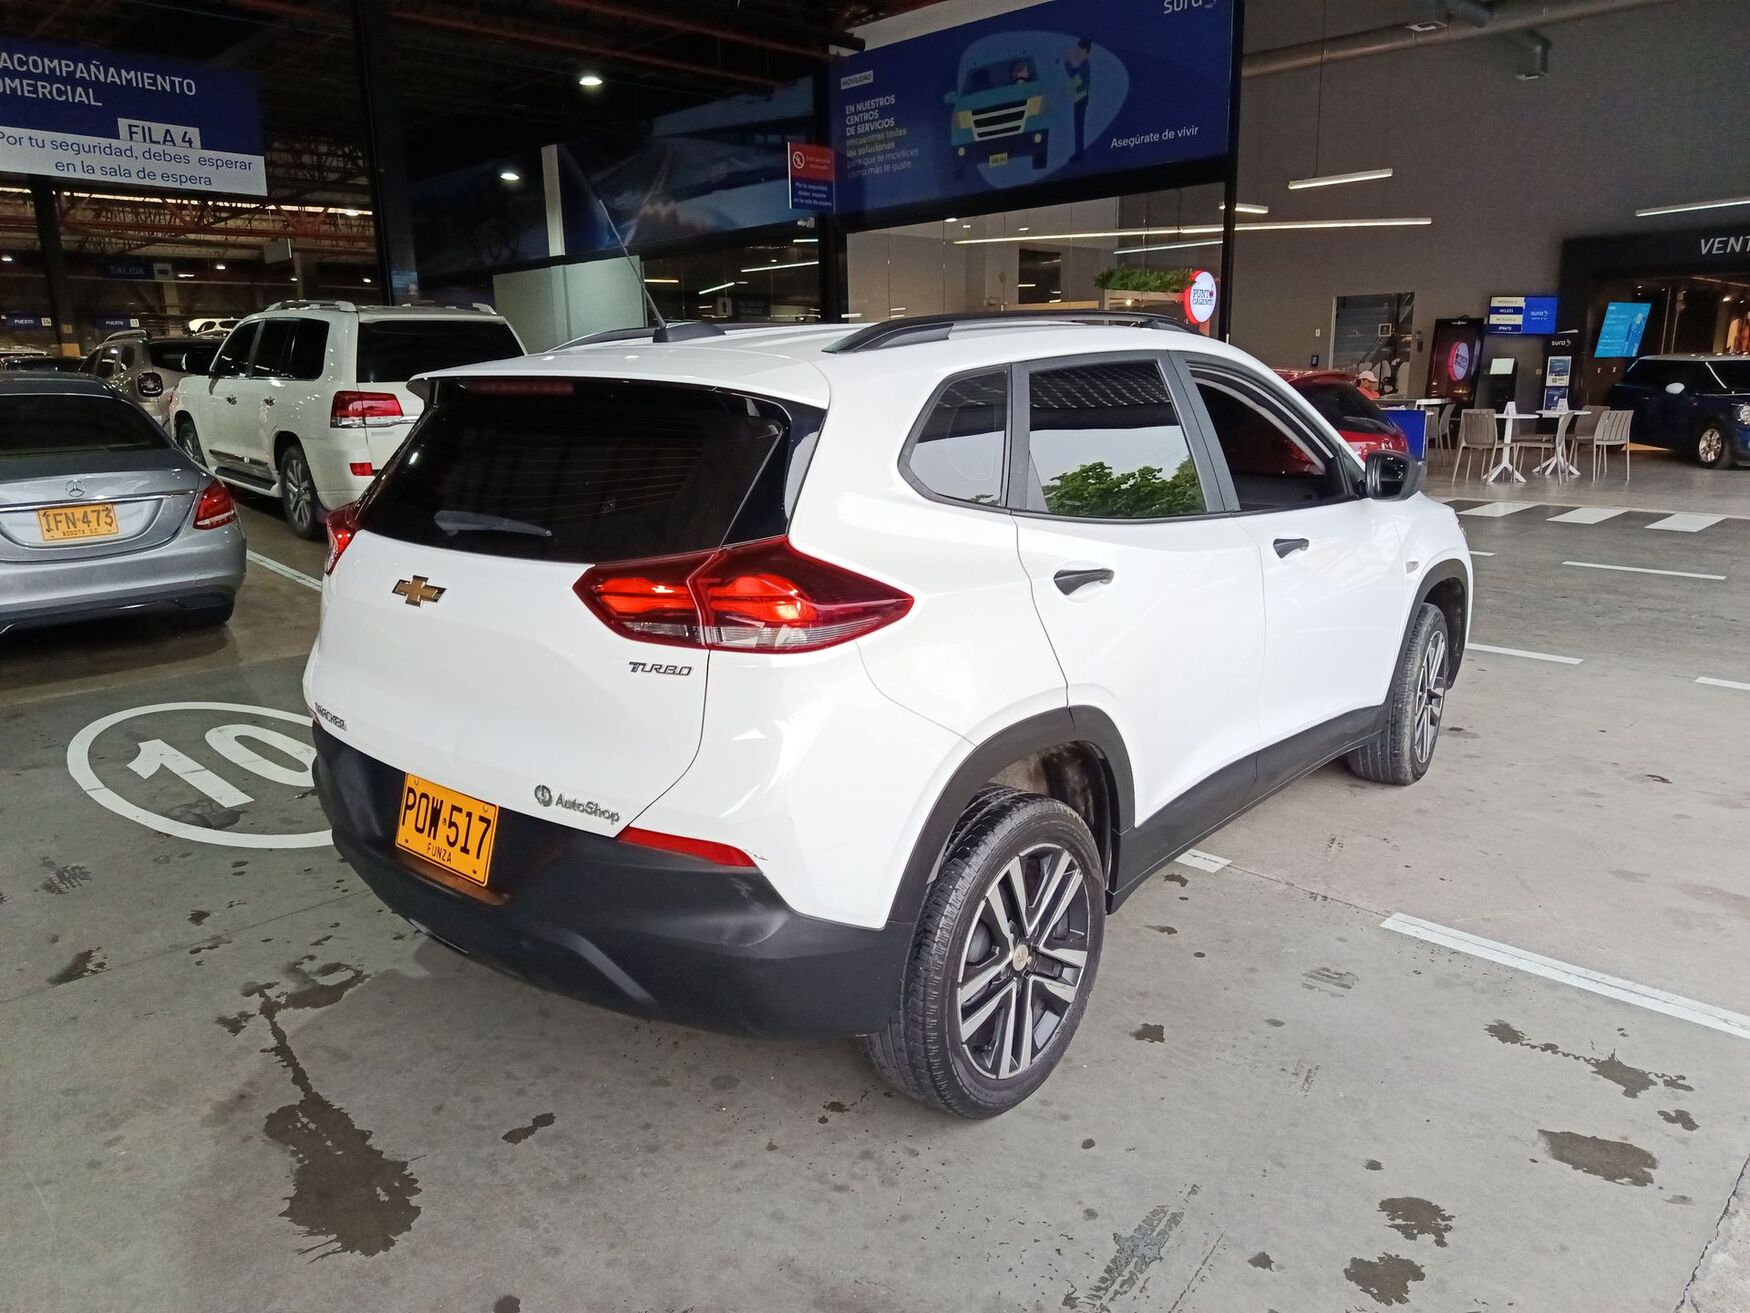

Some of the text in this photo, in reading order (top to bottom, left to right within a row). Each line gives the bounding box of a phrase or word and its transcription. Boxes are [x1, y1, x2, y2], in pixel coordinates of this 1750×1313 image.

[0, 51, 197, 96] ACOMPAÑAMIENTO
[0, 77, 103, 106] MERCIAL
[845, 109, 879, 125] CENTROS
[846, 95, 896, 115] EN NUESTROS
[127, 123, 194, 148] FILA 4
[846, 117, 896, 136] DE SERVICIOS
[1110, 125, 1199, 149] Asegúrate de vivir
[28, 135, 46, 149] tu
[50, 139, 139, 160] seguridad,
[142, 147, 191, 165] debes
[197, 156, 254, 172] esperar
[55, 160, 213, 187] en la sala de espera
[891, 160, 912, 173] guste
[628, 661, 692, 676] TURBO
[126, 723, 317, 808] 10
[555, 793, 620, 825] AutoShop
[426, 842, 452, 863] FUNZA
